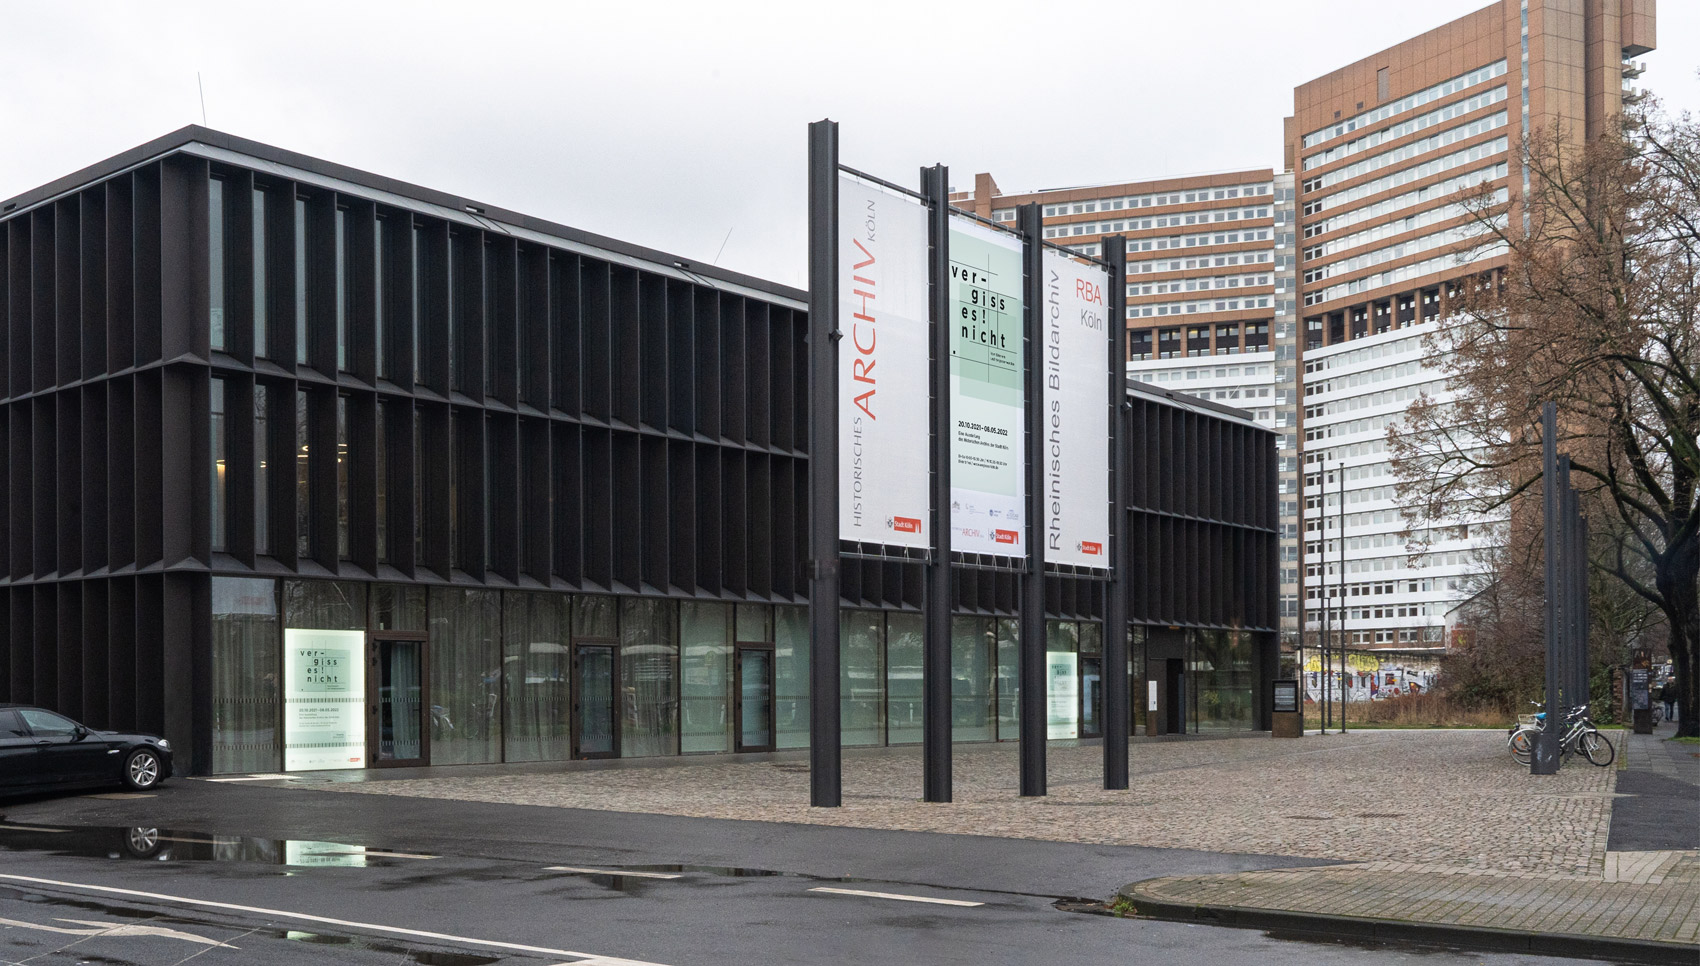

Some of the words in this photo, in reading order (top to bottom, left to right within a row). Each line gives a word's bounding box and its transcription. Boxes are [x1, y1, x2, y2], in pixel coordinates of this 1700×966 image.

[867, 199, 876, 242] KÖLN
[971, 289, 1006, 311] giss
[1076, 278, 1103, 306] RBA
[961, 306, 986, 324] es!
[1080, 308, 1103, 331] Köln
[853, 238, 876, 421] ARCHIV
[961, 325, 1006, 348] nicht
[1048, 270, 1060, 391] Bildarchiv
[853, 417, 862, 527] HISTORISCHES
[1049, 400, 1060, 551] Rheinisches
[894, 520, 904, 528] Stadt
[904, 521, 913, 529] Köln
[306, 666, 324, 674] es!
[313, 658, 338, 666] giss
[306, 674, 338, 683] nicht
